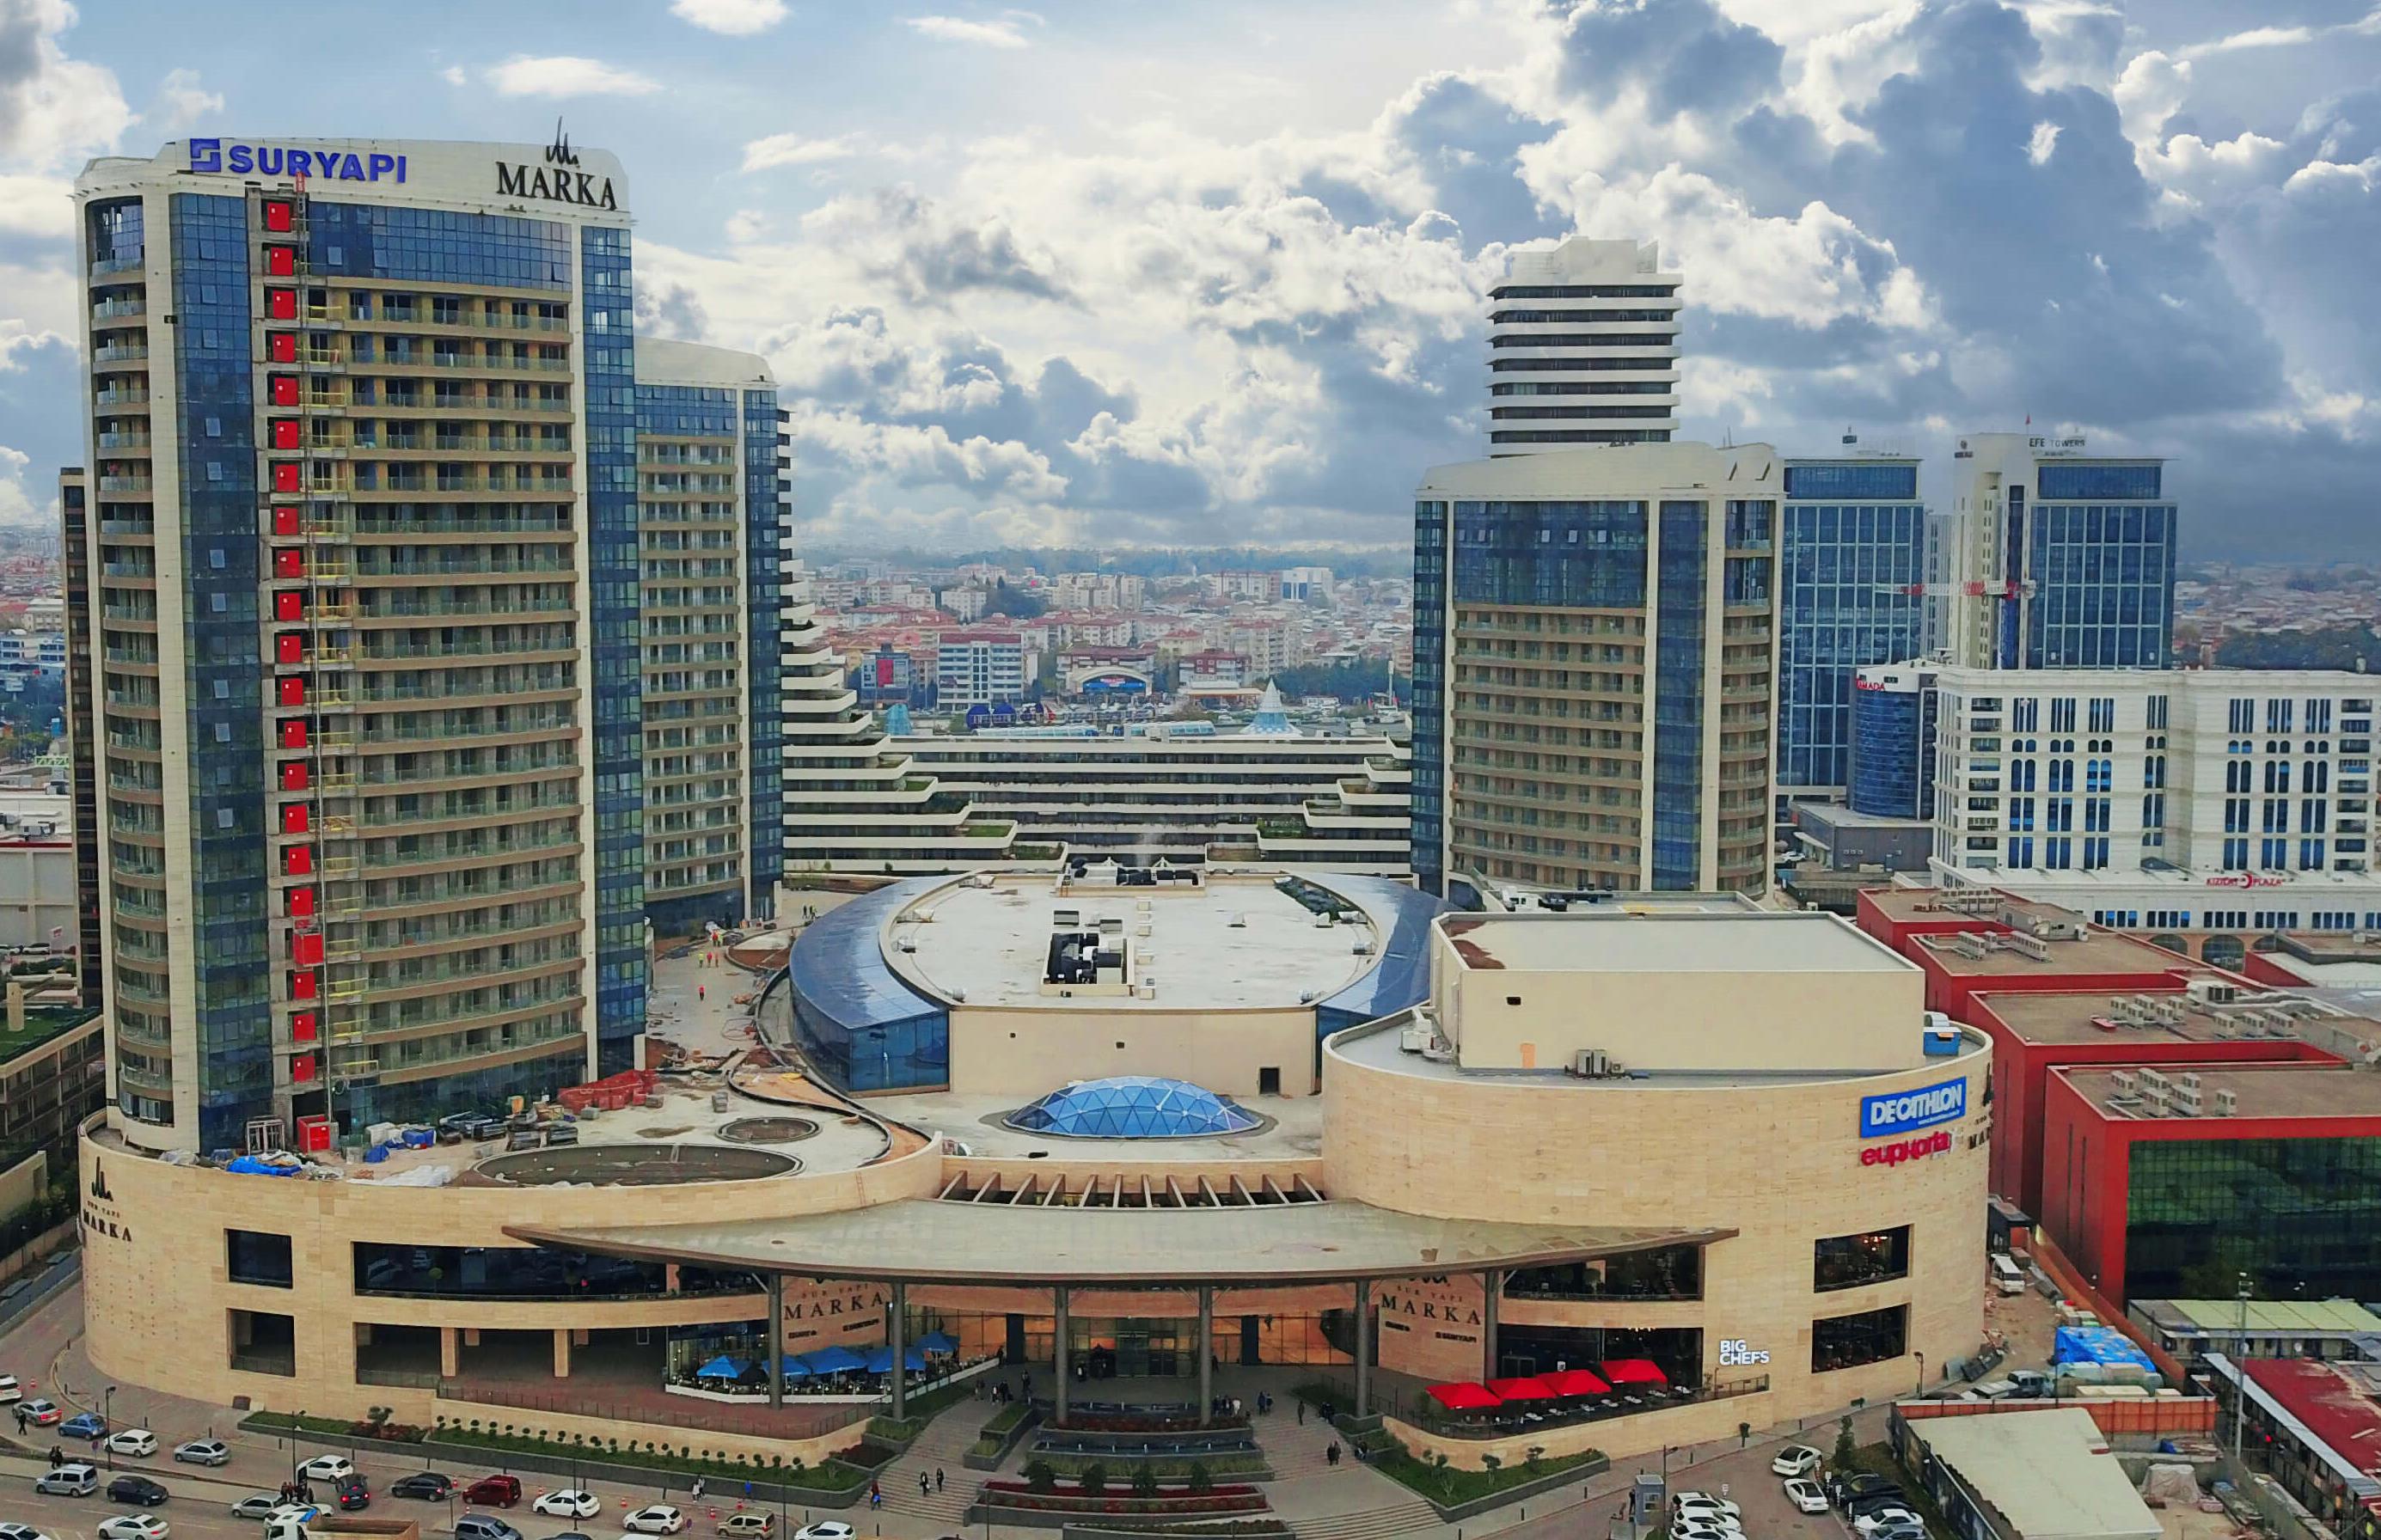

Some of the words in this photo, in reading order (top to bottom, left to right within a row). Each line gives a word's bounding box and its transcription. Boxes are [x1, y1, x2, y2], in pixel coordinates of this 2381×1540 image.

[229, 145, 407, 183] SURYAPI
[495, 161, 618, 211] MARKA
[2029, 437, 2046, 448] EFE
[1870, 1084, 1962, 1126] DECATHLON
[784, 1292, 883, 1320] MARKA
[1381, 1292, 1480, 1325] MARKA
[1719, 1351, 1770, 1366] CHEFS
[1720, 1340, 1747, 1353] BIG
